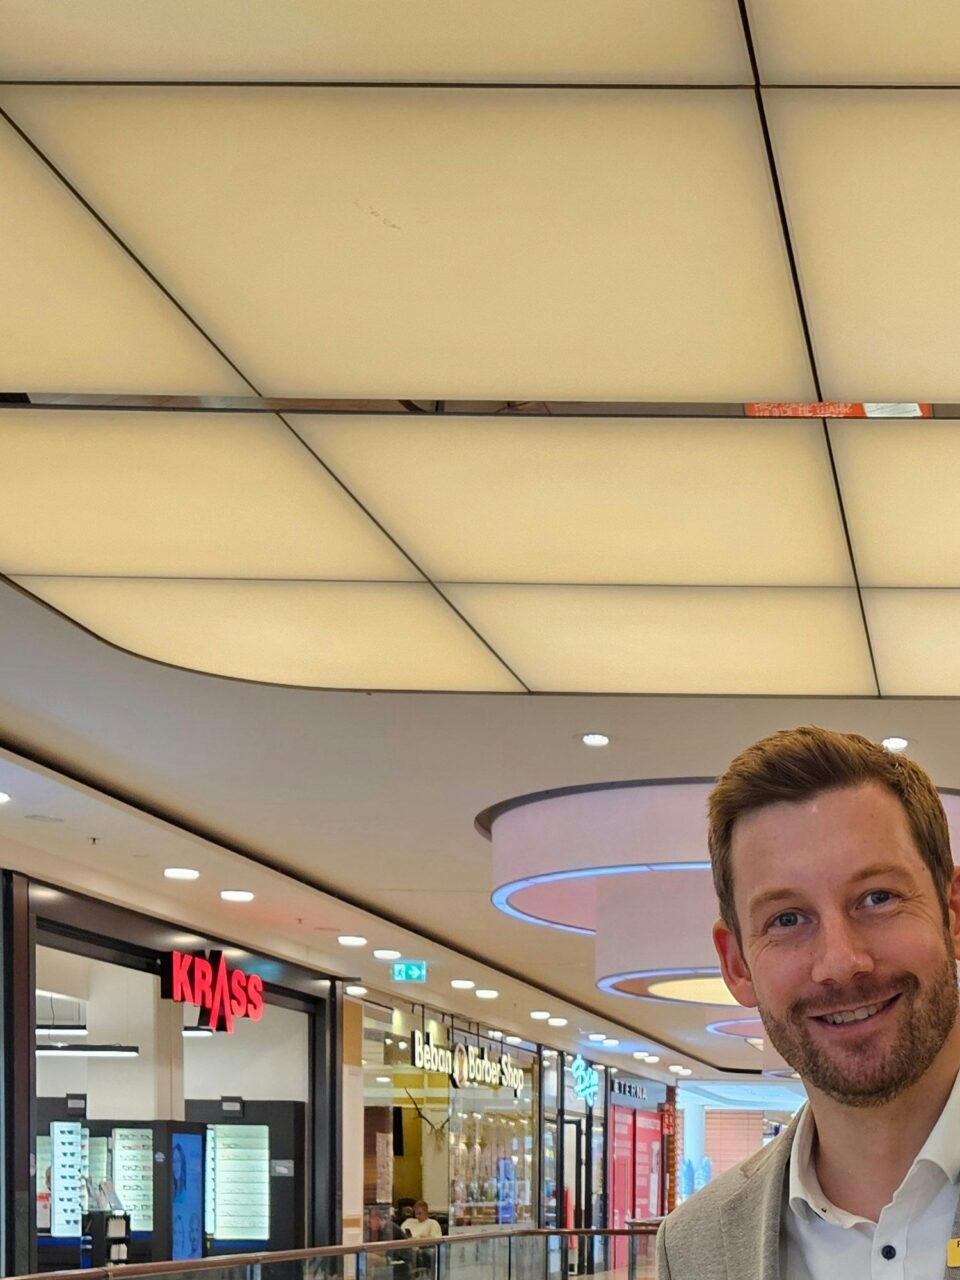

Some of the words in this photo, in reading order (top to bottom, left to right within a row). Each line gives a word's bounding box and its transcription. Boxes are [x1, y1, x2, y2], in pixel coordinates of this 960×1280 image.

[172, 950, 265, 1034] KRASS
[414, 1029, 453, 1075] Beban
[468, 1044, 501, 1085] Barber
[501, 1053, 524, 1099] Shop
[613, 1079, 648, 1100] ETERNA
